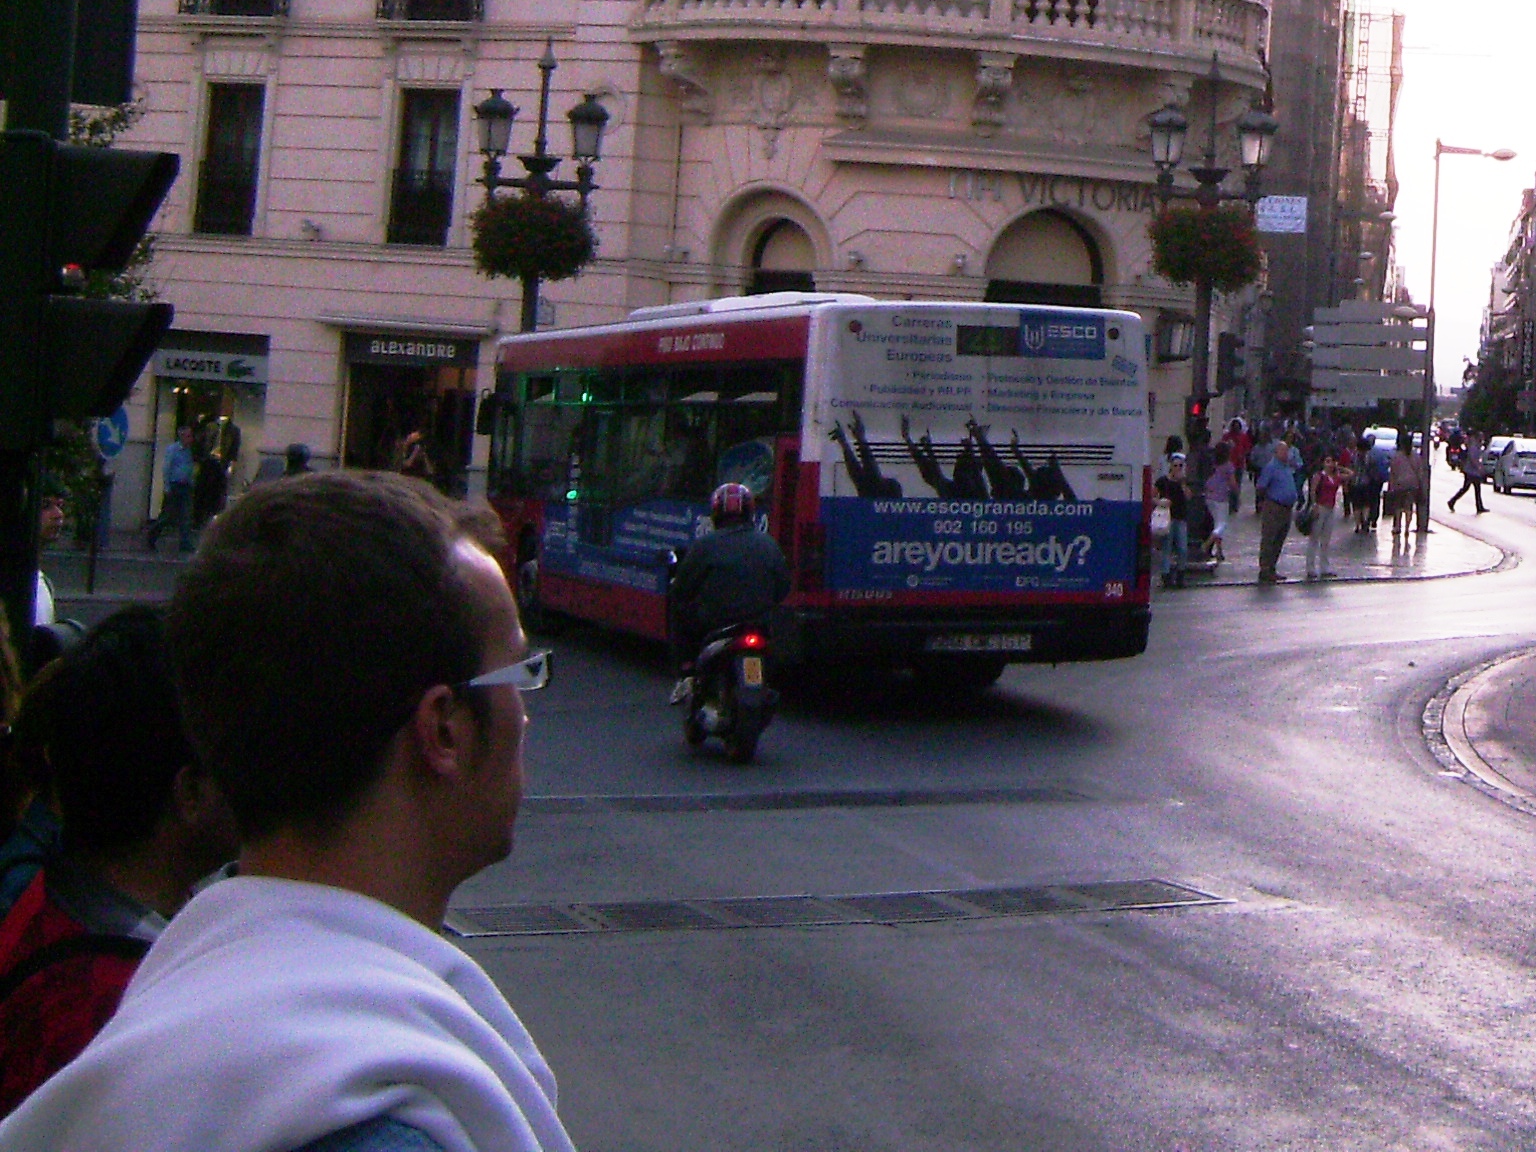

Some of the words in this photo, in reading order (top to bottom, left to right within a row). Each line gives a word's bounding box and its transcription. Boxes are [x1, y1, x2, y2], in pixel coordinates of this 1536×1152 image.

[1018, 176, 1156, 214] VICTORIA
[891, 314, 953, 329] Carreras
[856, 332, 953, 346] Universitarias
[1047, 323, 1098, 340] ESCO
[886, 348, 953, 364] Europeas
[165, 357, 222, 374] LACOSTE
[873, 499, 1093, 518] www.escogranada.com
[933, 520, 962, 535] 902
[969, 520, 998, 535] 160
[1005, 520, 1034, 536] 195
[870, 533, 1093, 573] areyouready?
